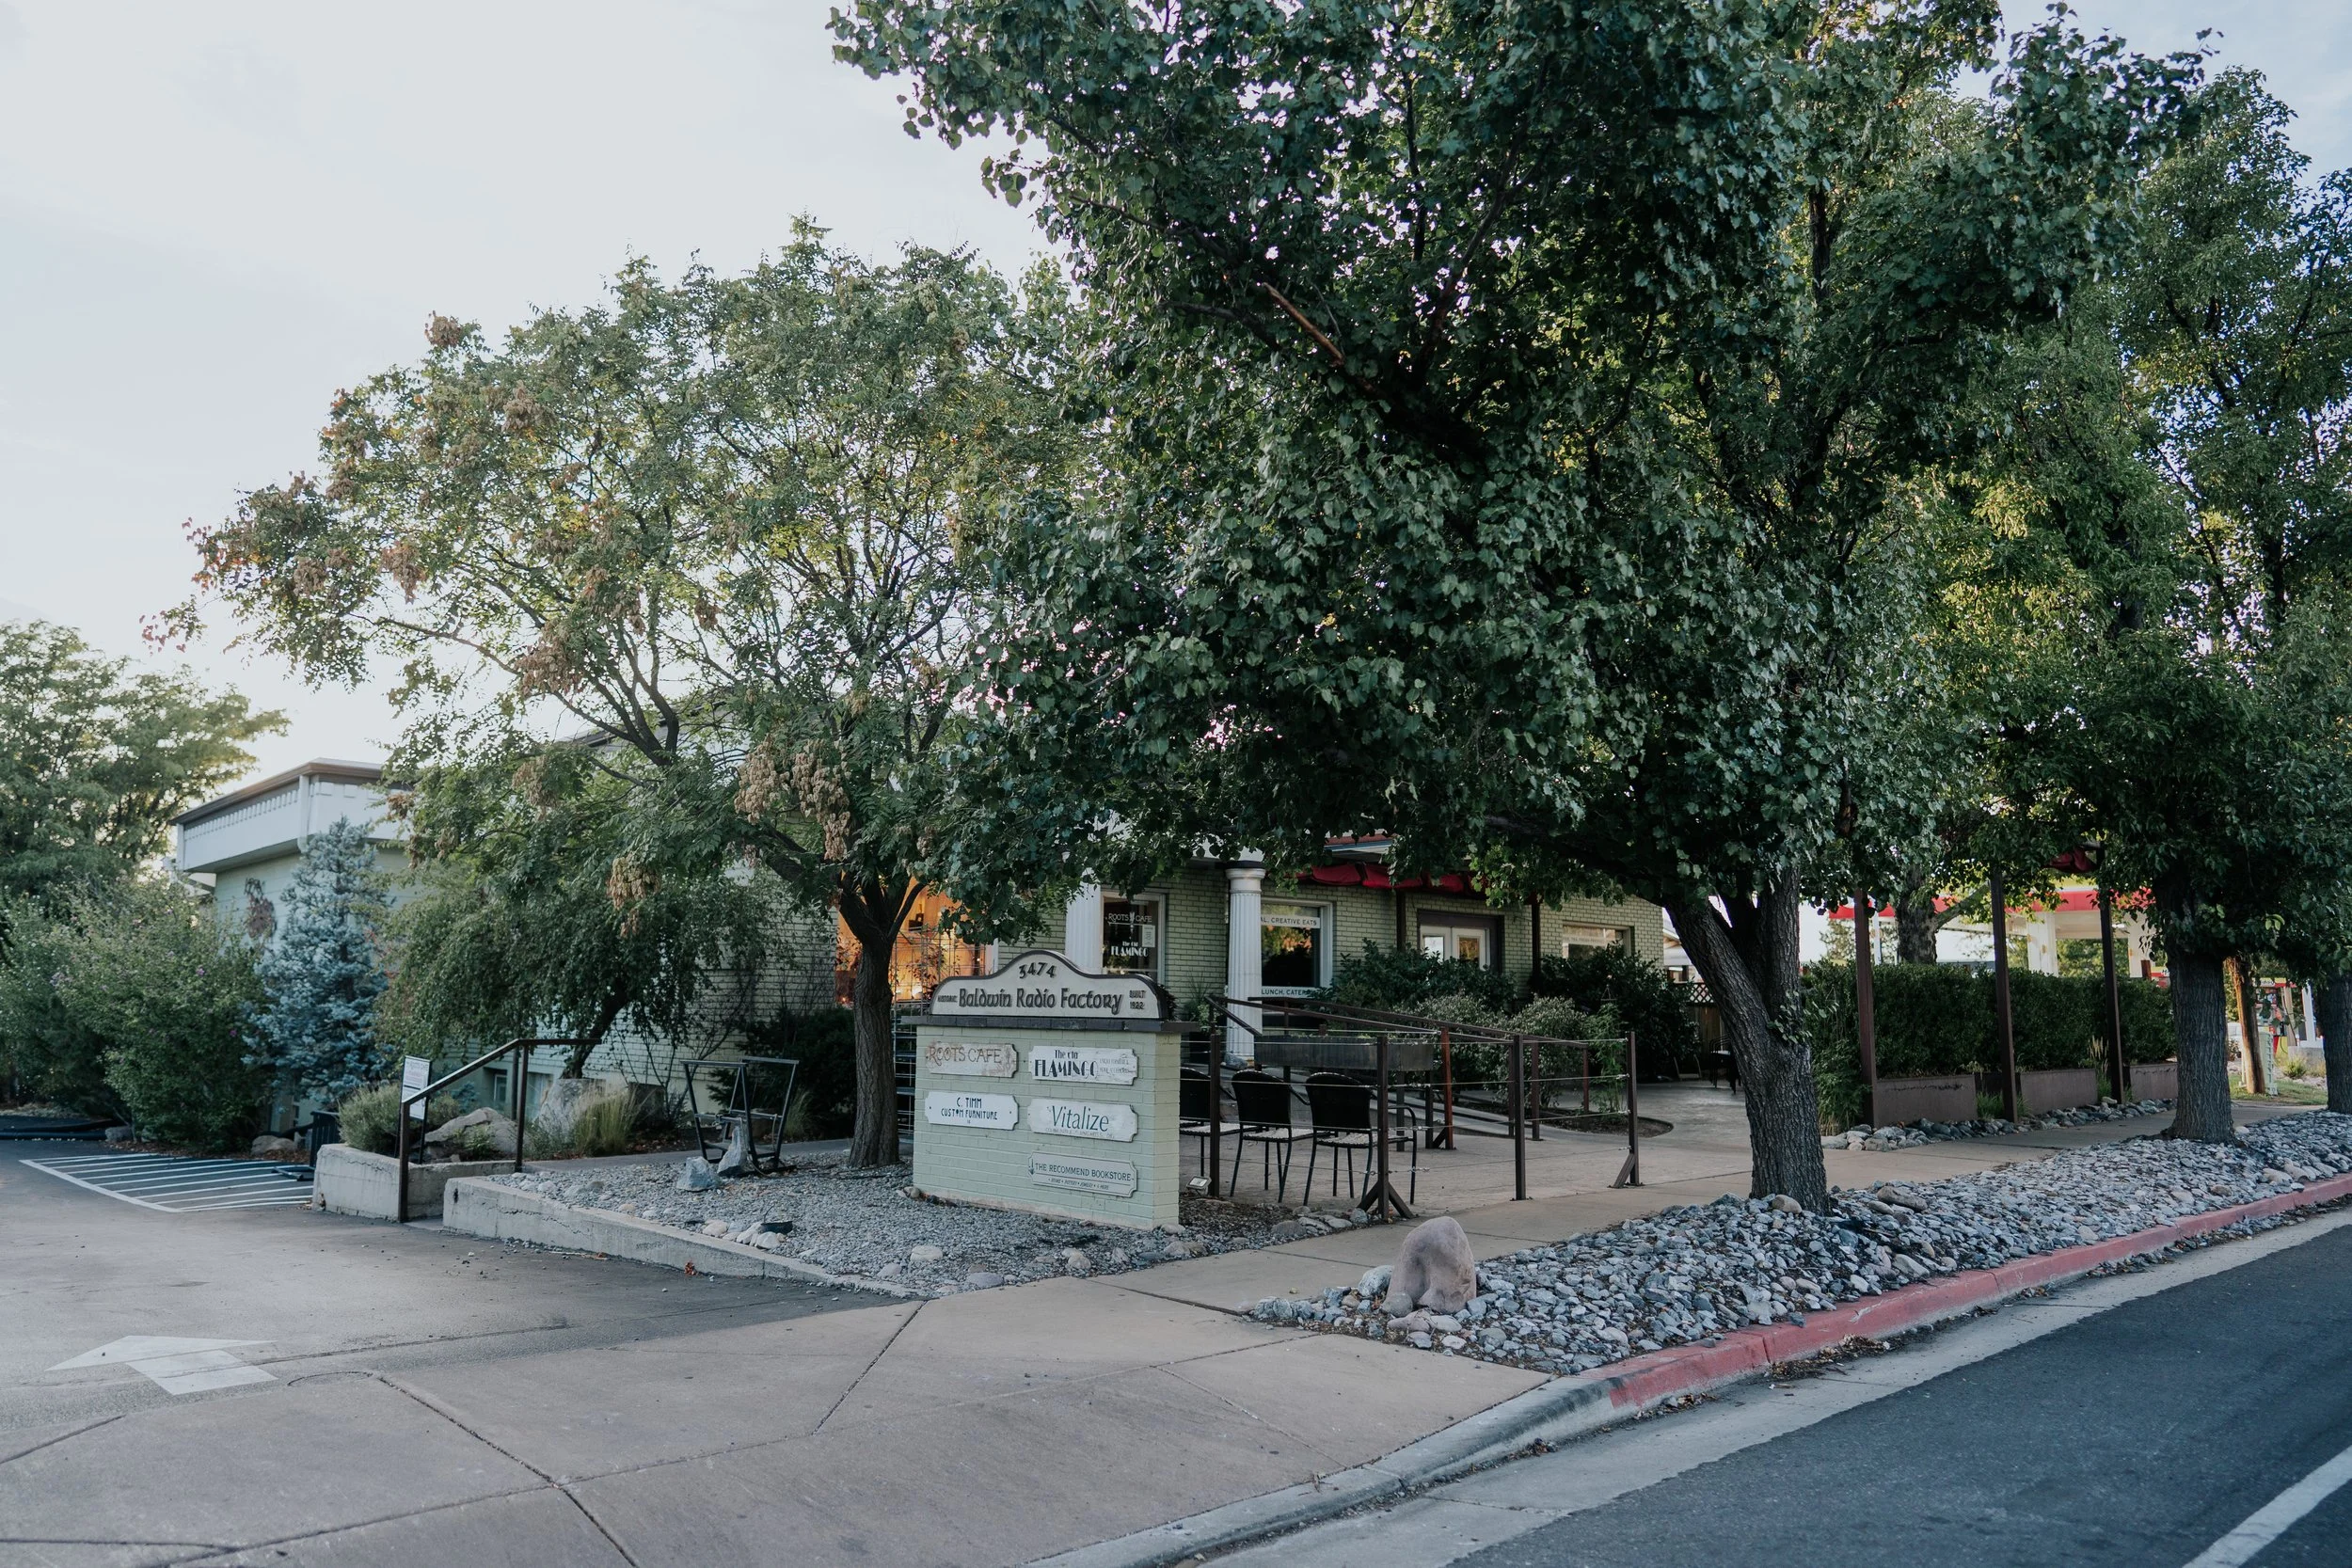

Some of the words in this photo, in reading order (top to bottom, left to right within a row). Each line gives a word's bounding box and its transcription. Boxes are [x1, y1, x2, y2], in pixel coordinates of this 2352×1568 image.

[1107, 912, 1129, 922] ROOTS
[1270, 917, 1301, 926] CREATIVE
[1110, 945, 1149, 958] FLAMINGO
[1018, 961, 1057, 979] 3474
[959, 988, 1012, 1007] Baldwin
[1016, 988, 1056, 1008] Radio
[1060, 988, 1123, 1015] Factory
[929, 1046, 966, 1066] ROOTS
[967, 1048, 1002, 1064] CAFE
[1055, 1049, 1066, 1059] The
[1034, 1059, 1099, 1079] FLAMINGO
[965, 1097, 982, 1109] TIMM
[941, 1108, 964, 1117] CUSTOM
[965, 1109, 998, 1120] FURNITURE
[1052, 1105, 1109, 1132] Vitalize
[1035, 1163, 1047, 1171] THE
[1049, 1164, 1089, 1177] RECOMMEND
[1091, 1169, 1132, 1181] BOOKSTORE
